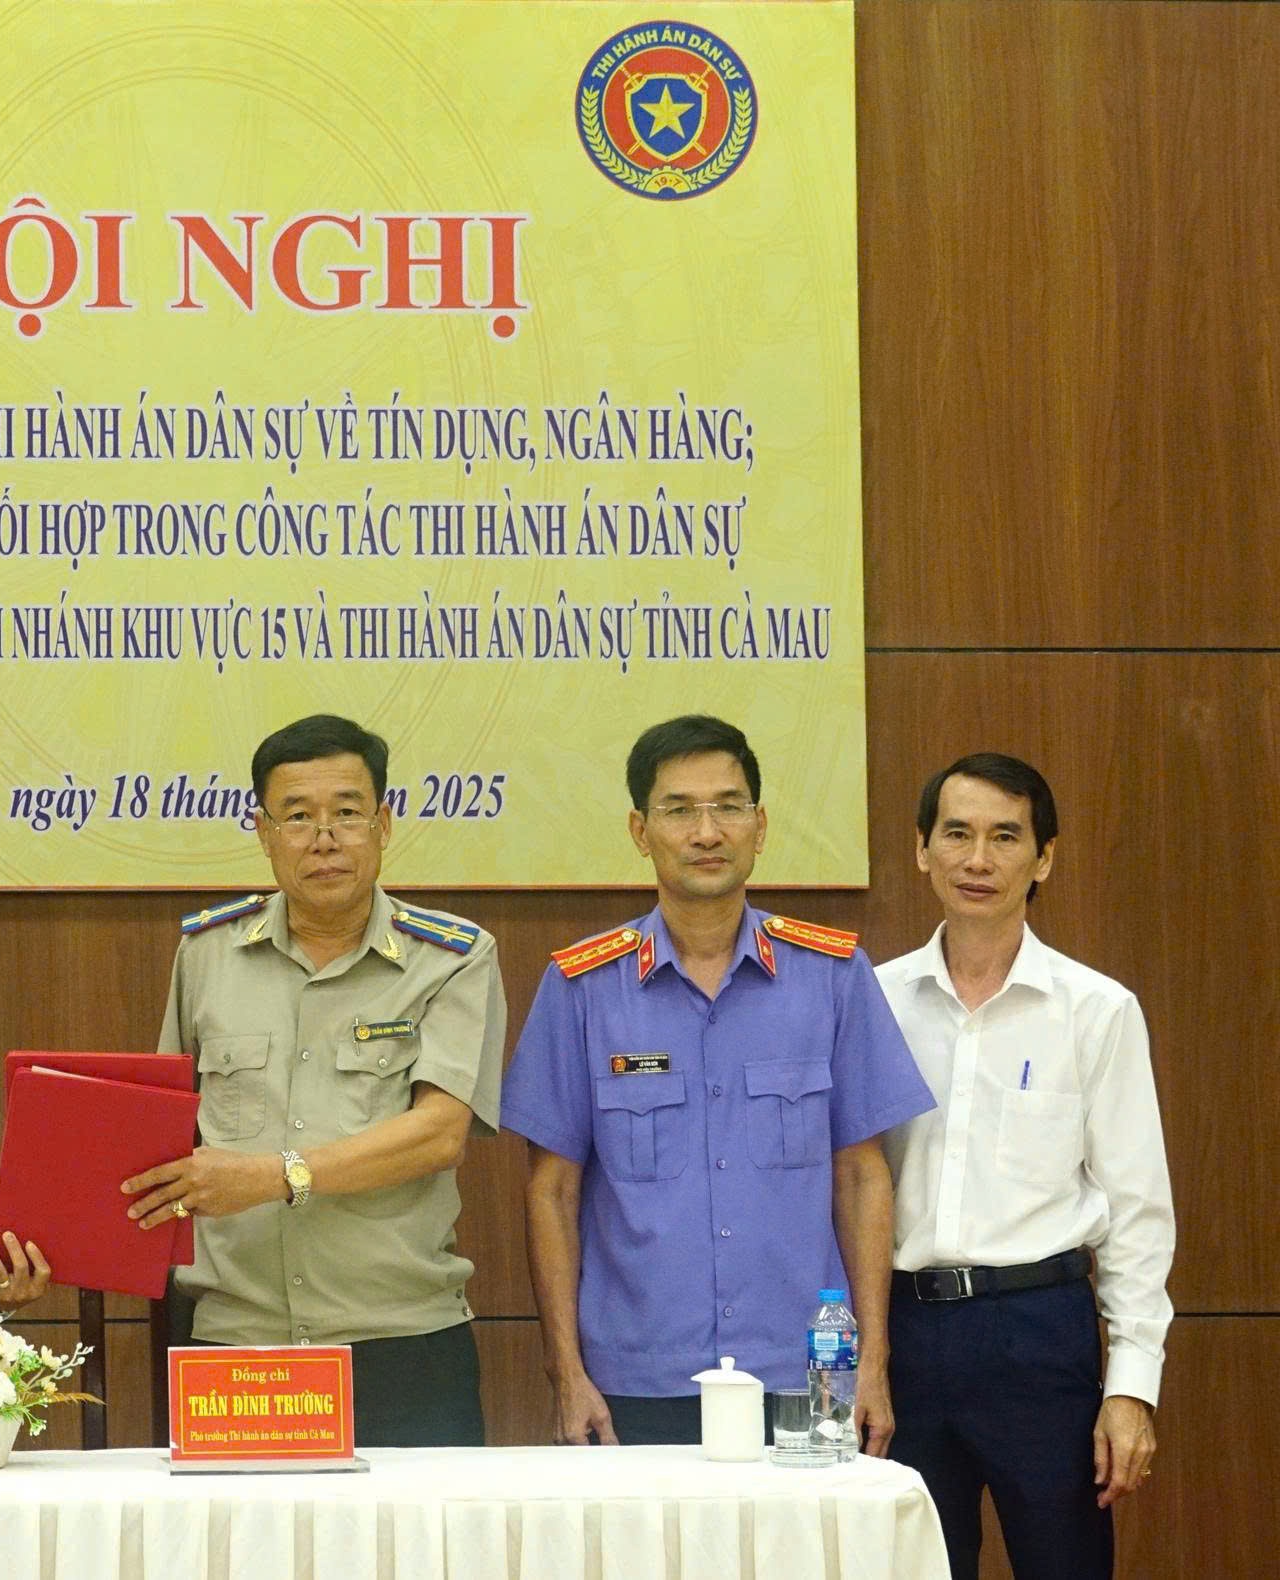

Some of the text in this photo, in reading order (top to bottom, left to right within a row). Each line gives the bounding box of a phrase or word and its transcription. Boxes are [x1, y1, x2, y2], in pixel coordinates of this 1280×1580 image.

[591, 26, 743, 82] THI HÀNH ÁN DÂN SỰ
[170, 214, 528, 339] NGHỊ
[25, 390, 121, 459] HÀNH
[130, 391, 176, 459] ÁN
[185, 390, 255, 460] DÂN
[264, 400, 308, 475] SỰ
[316, 392, 359, 460] VỀ
[367, 392, 424, 460] TÍN
[433, 407, 538, 475] DỤNG,
[544, 390, 638, 460] NGÂN
[648, 392, 754, 472] HÀNG;
[39, 499, 107, 571] HỢP
[112, 503, 227, 556] TRONG
[235, 486, 328, 557] CÔNG
[336, 487, 401, 557] TÁC
[409, 504, 465, 556] THI
[475, 488, 567, 556] HÀNH
[575, 488, 620, 556] ÁN
[629, 487, 695, 556] DÂN
[703, 495, 747, 571] SỰ
[11, 590, 114, 660] NHÁNH
[122, 606, 184, 660] KHU
[192, 599, 252, 674] VỰC
[260, 607, 287, 660] 15
[293, 590, 334, 660] VÀ
[340, 607, 390, 660] THI
[397, 590, 479, 660] HÀNH
[486, 590, 525, 660] ÁN
[533, 589, 593, 660] DÂN
[600, 598, 637, 675] SỰ
[642, 591, 713, 660] TỈNH
[720, 590, 760, 660] CÀ
[766, 606, 832, 661] MAU
[9, 774, 97, 831] ngày
[107, 774, 151, 819] 18
[160, 774, 260, 831] tháng
[418, 774, 506, 818] 2025
[188, 1388, 334, 1417] TRẦN ĐÌNH TRƯỜNG
[232, 1366, 290, 1384] Đồng chí
